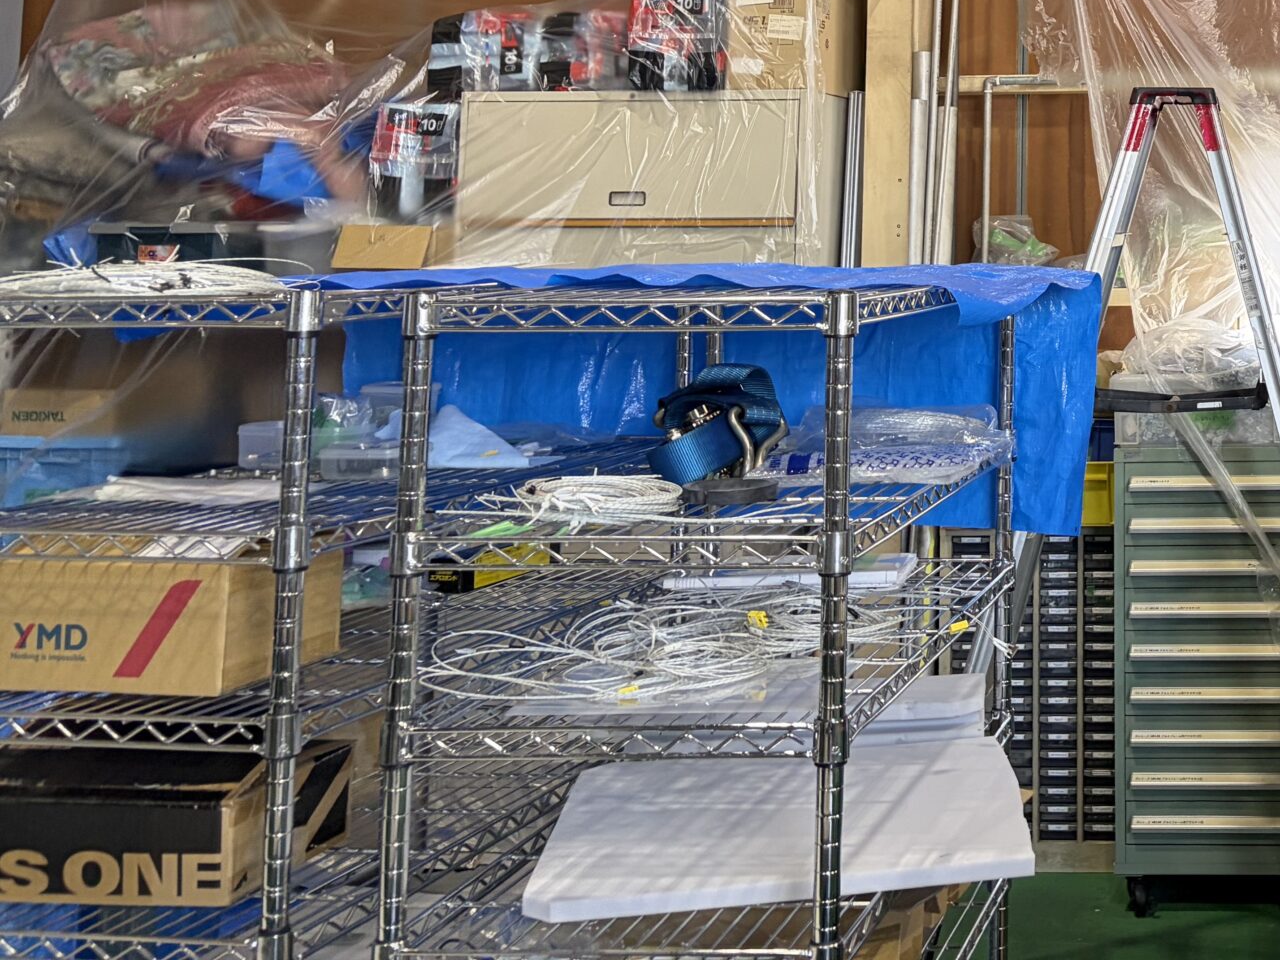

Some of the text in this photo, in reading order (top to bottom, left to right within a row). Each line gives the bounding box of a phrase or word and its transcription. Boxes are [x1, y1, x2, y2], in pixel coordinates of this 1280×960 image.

[421, 118, 437, 131] 10
[12, 410, 65, 422] TAKIGEN
[13, 622, 88, 651] YMD
[62, 850, 222, 897] ONE
